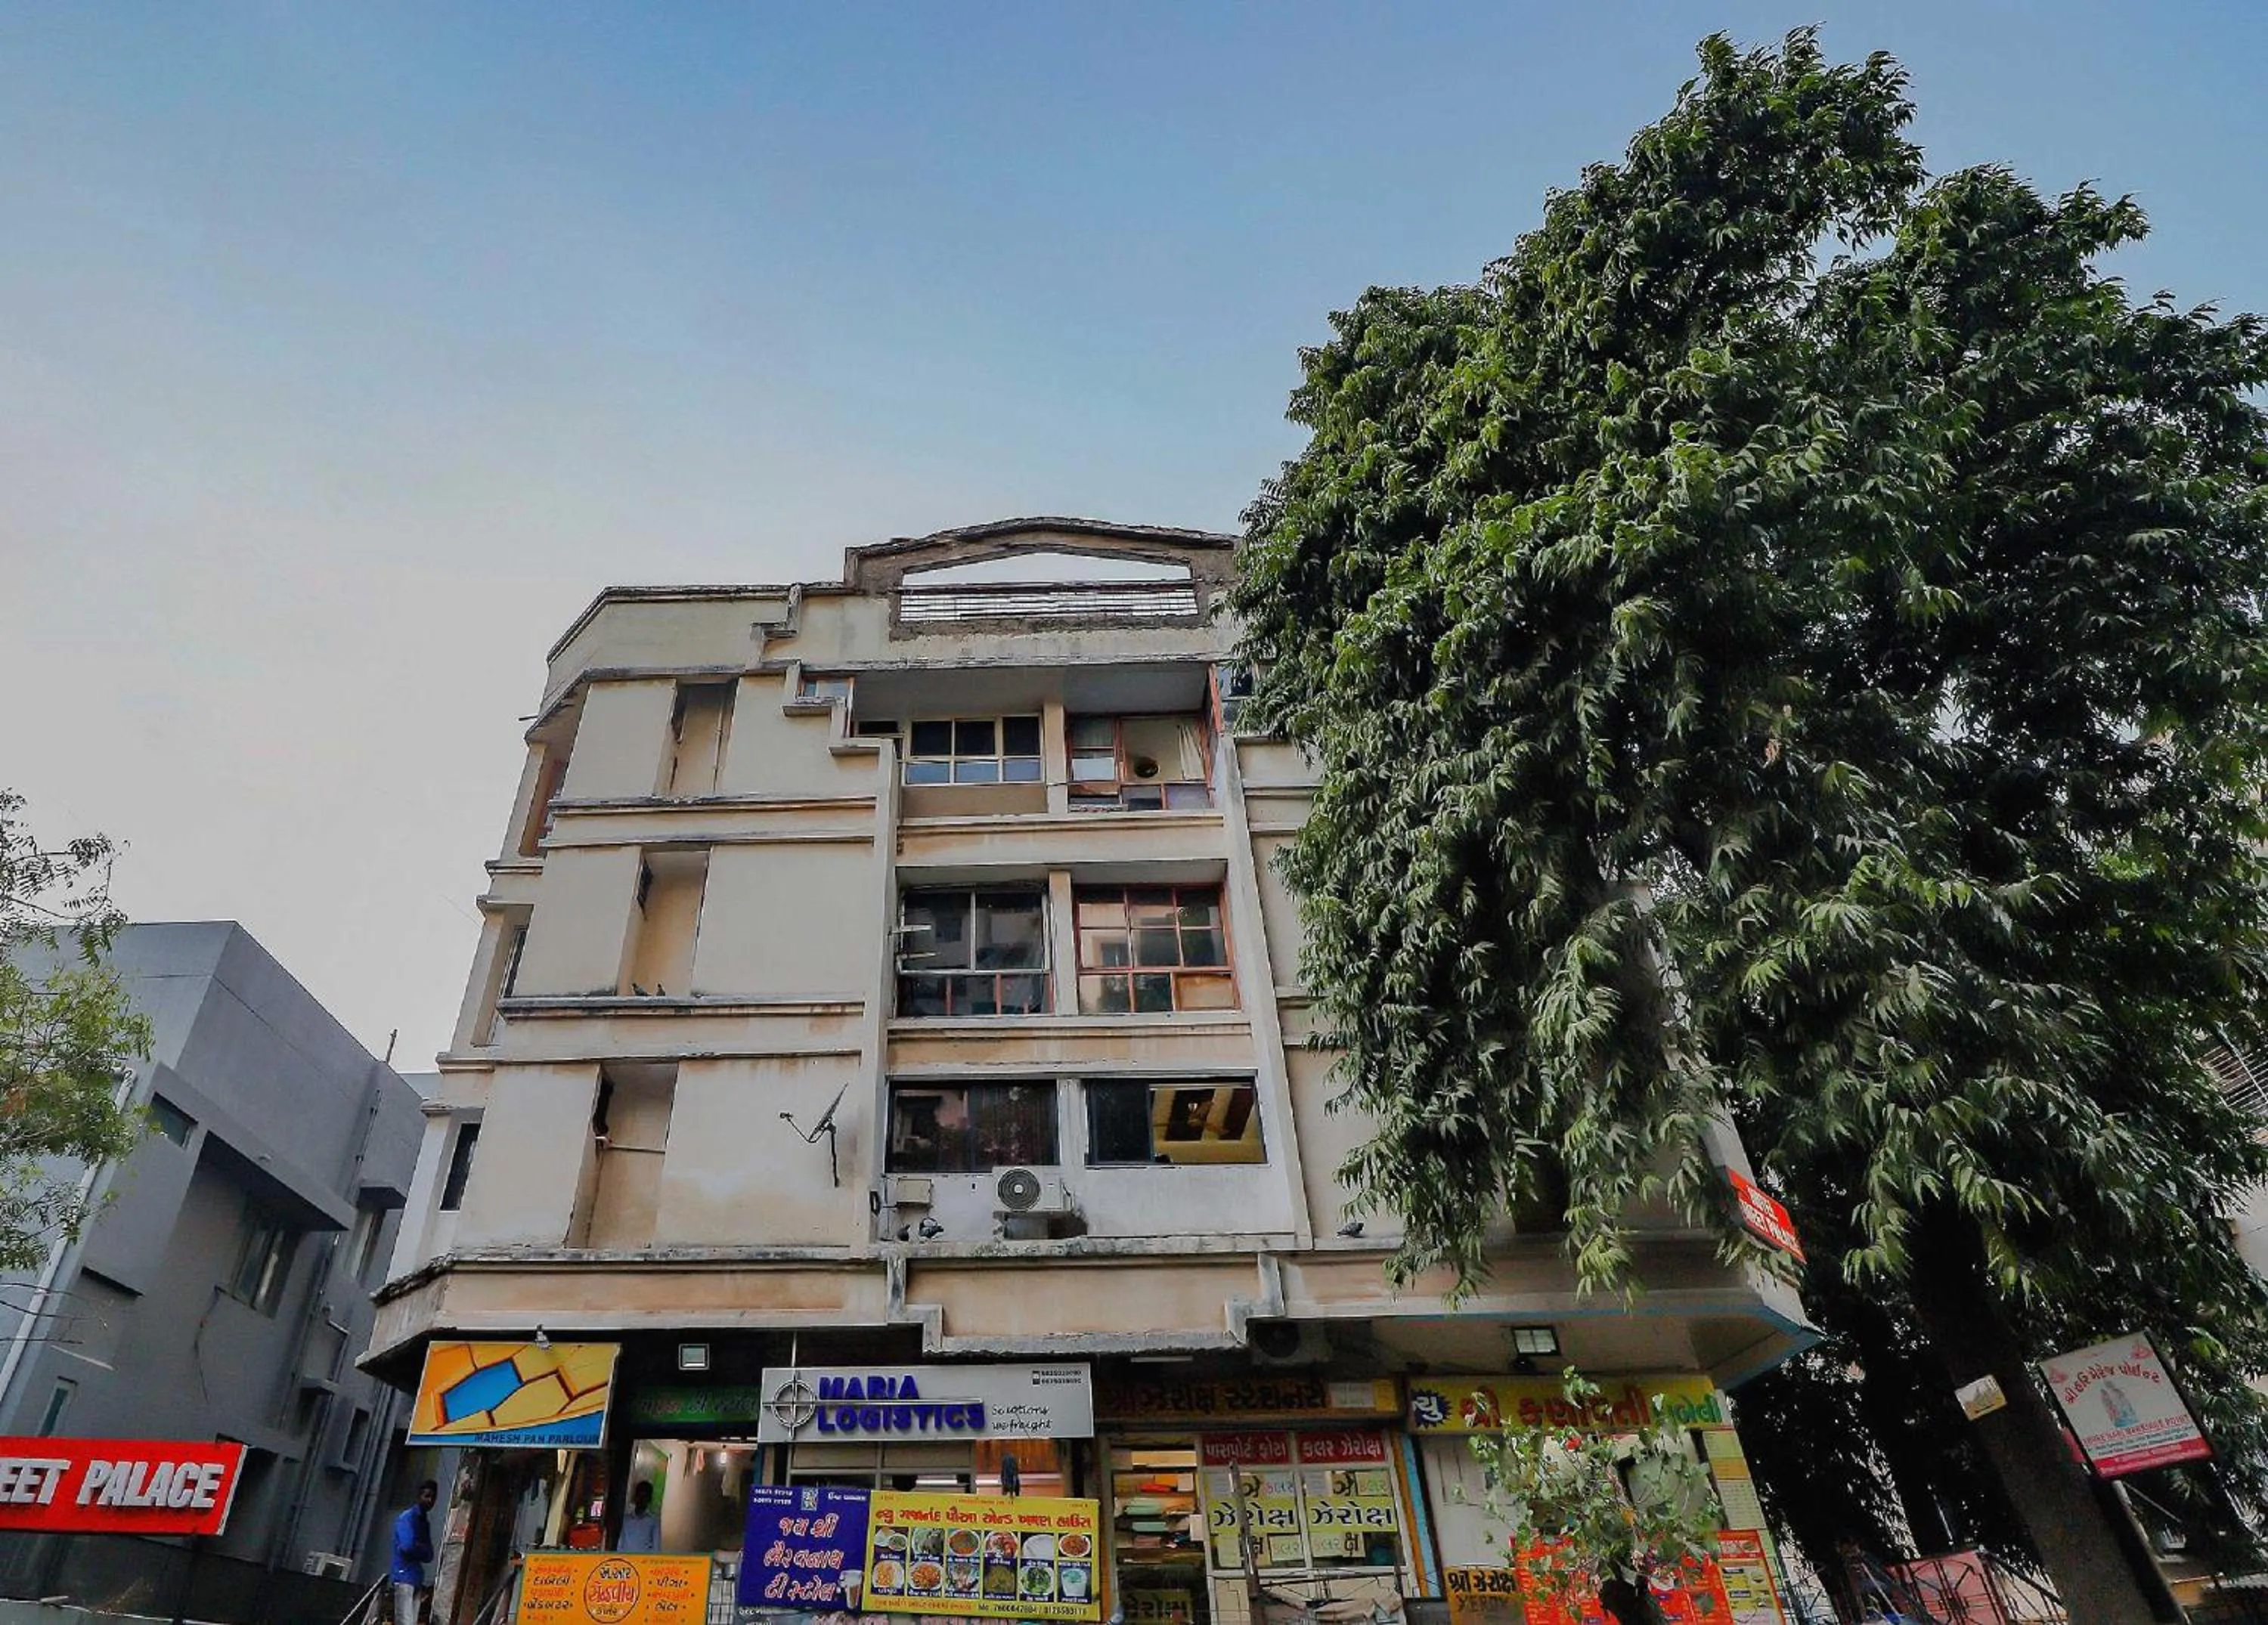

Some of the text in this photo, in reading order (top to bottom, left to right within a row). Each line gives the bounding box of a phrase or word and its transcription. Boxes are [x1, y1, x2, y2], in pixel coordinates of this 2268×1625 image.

[819, 1375, 920, 1400] MARIA
[816, 1404, 985, 1433] LOGISTICS
[76, 1459, 225, 1508] PALACE
[779, 1517, 809, 1537] જય
[1309, 1500, 1393, 1528] ઝેરોક્ષ
